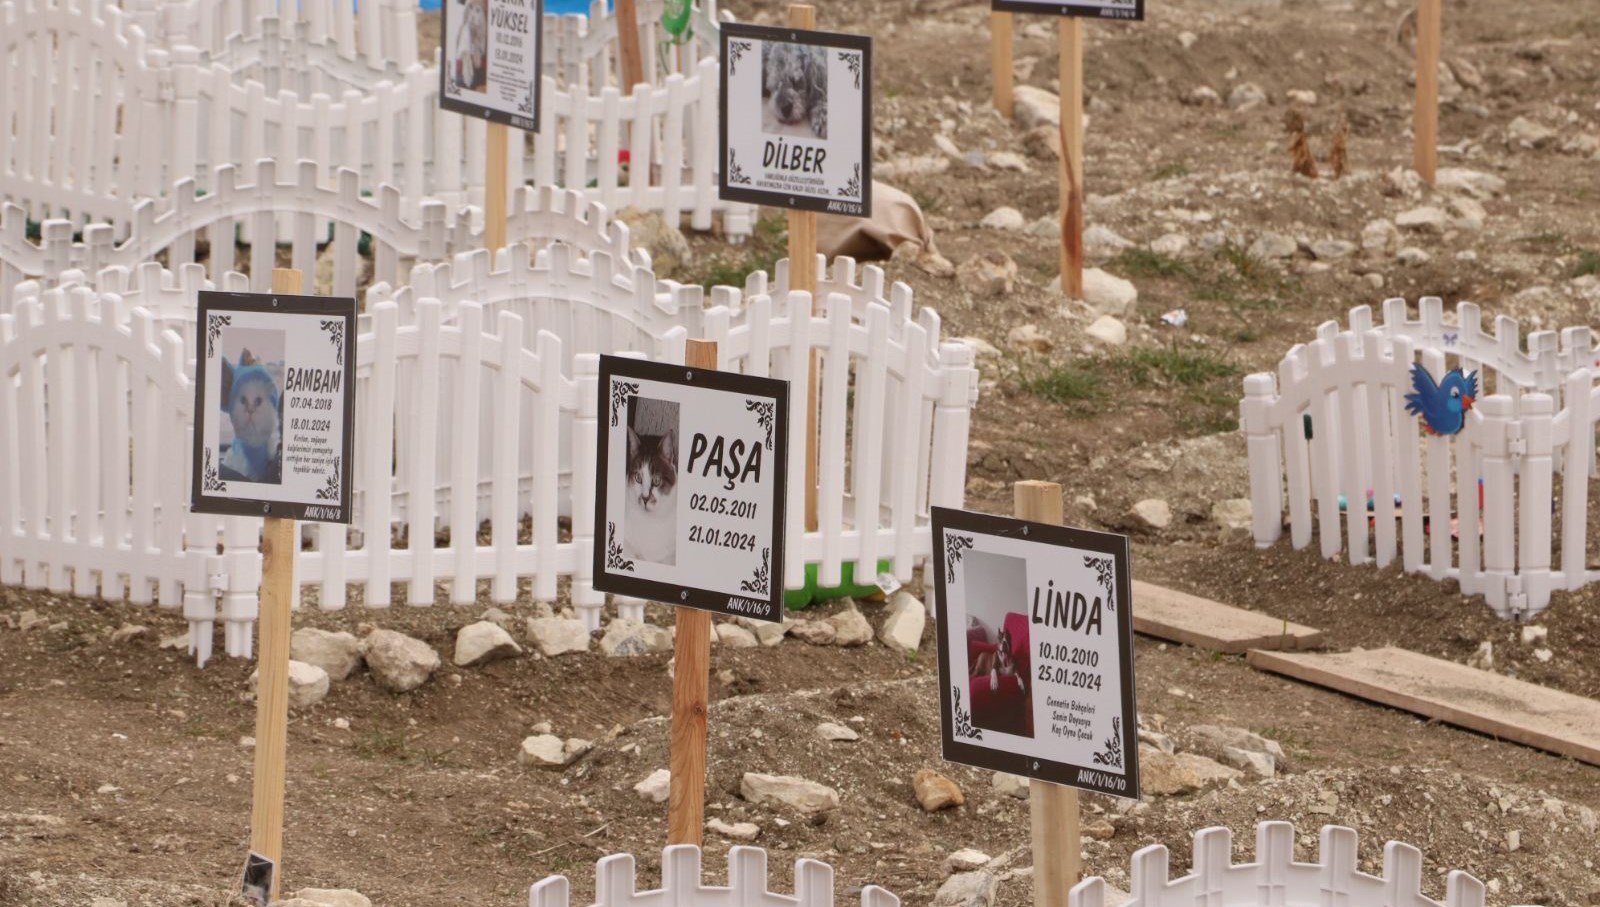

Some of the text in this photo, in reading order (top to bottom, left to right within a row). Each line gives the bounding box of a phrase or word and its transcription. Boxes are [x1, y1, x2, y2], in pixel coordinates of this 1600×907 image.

[491, 5, 528, 33] YÜKSEL
[762, 137, 827, 174] DİLBER
[286, 367, 341, 394] BAMBAM
[290, 396, 332, 410] 07.04.2018
[291, 418, 331, 431] 18.01.2024
[687, 432, 763, 490] PAŞA
[304, 505, 342, 520] ANK/1/16/8
[689, 493, 757, 520] 02.05.2011
[688, 525, 756, 552] 21.01.2024
[727, 596, 771, 616] ANK/1/16/9
[1032, 580, 1102, 636] LİNDA
[1039, 642, 1099, 668] 10.10.2010
[1038, 664, 1102, 692] 25.01.2024
[1077, 769, 1127, 791] ANK/1/16/10
